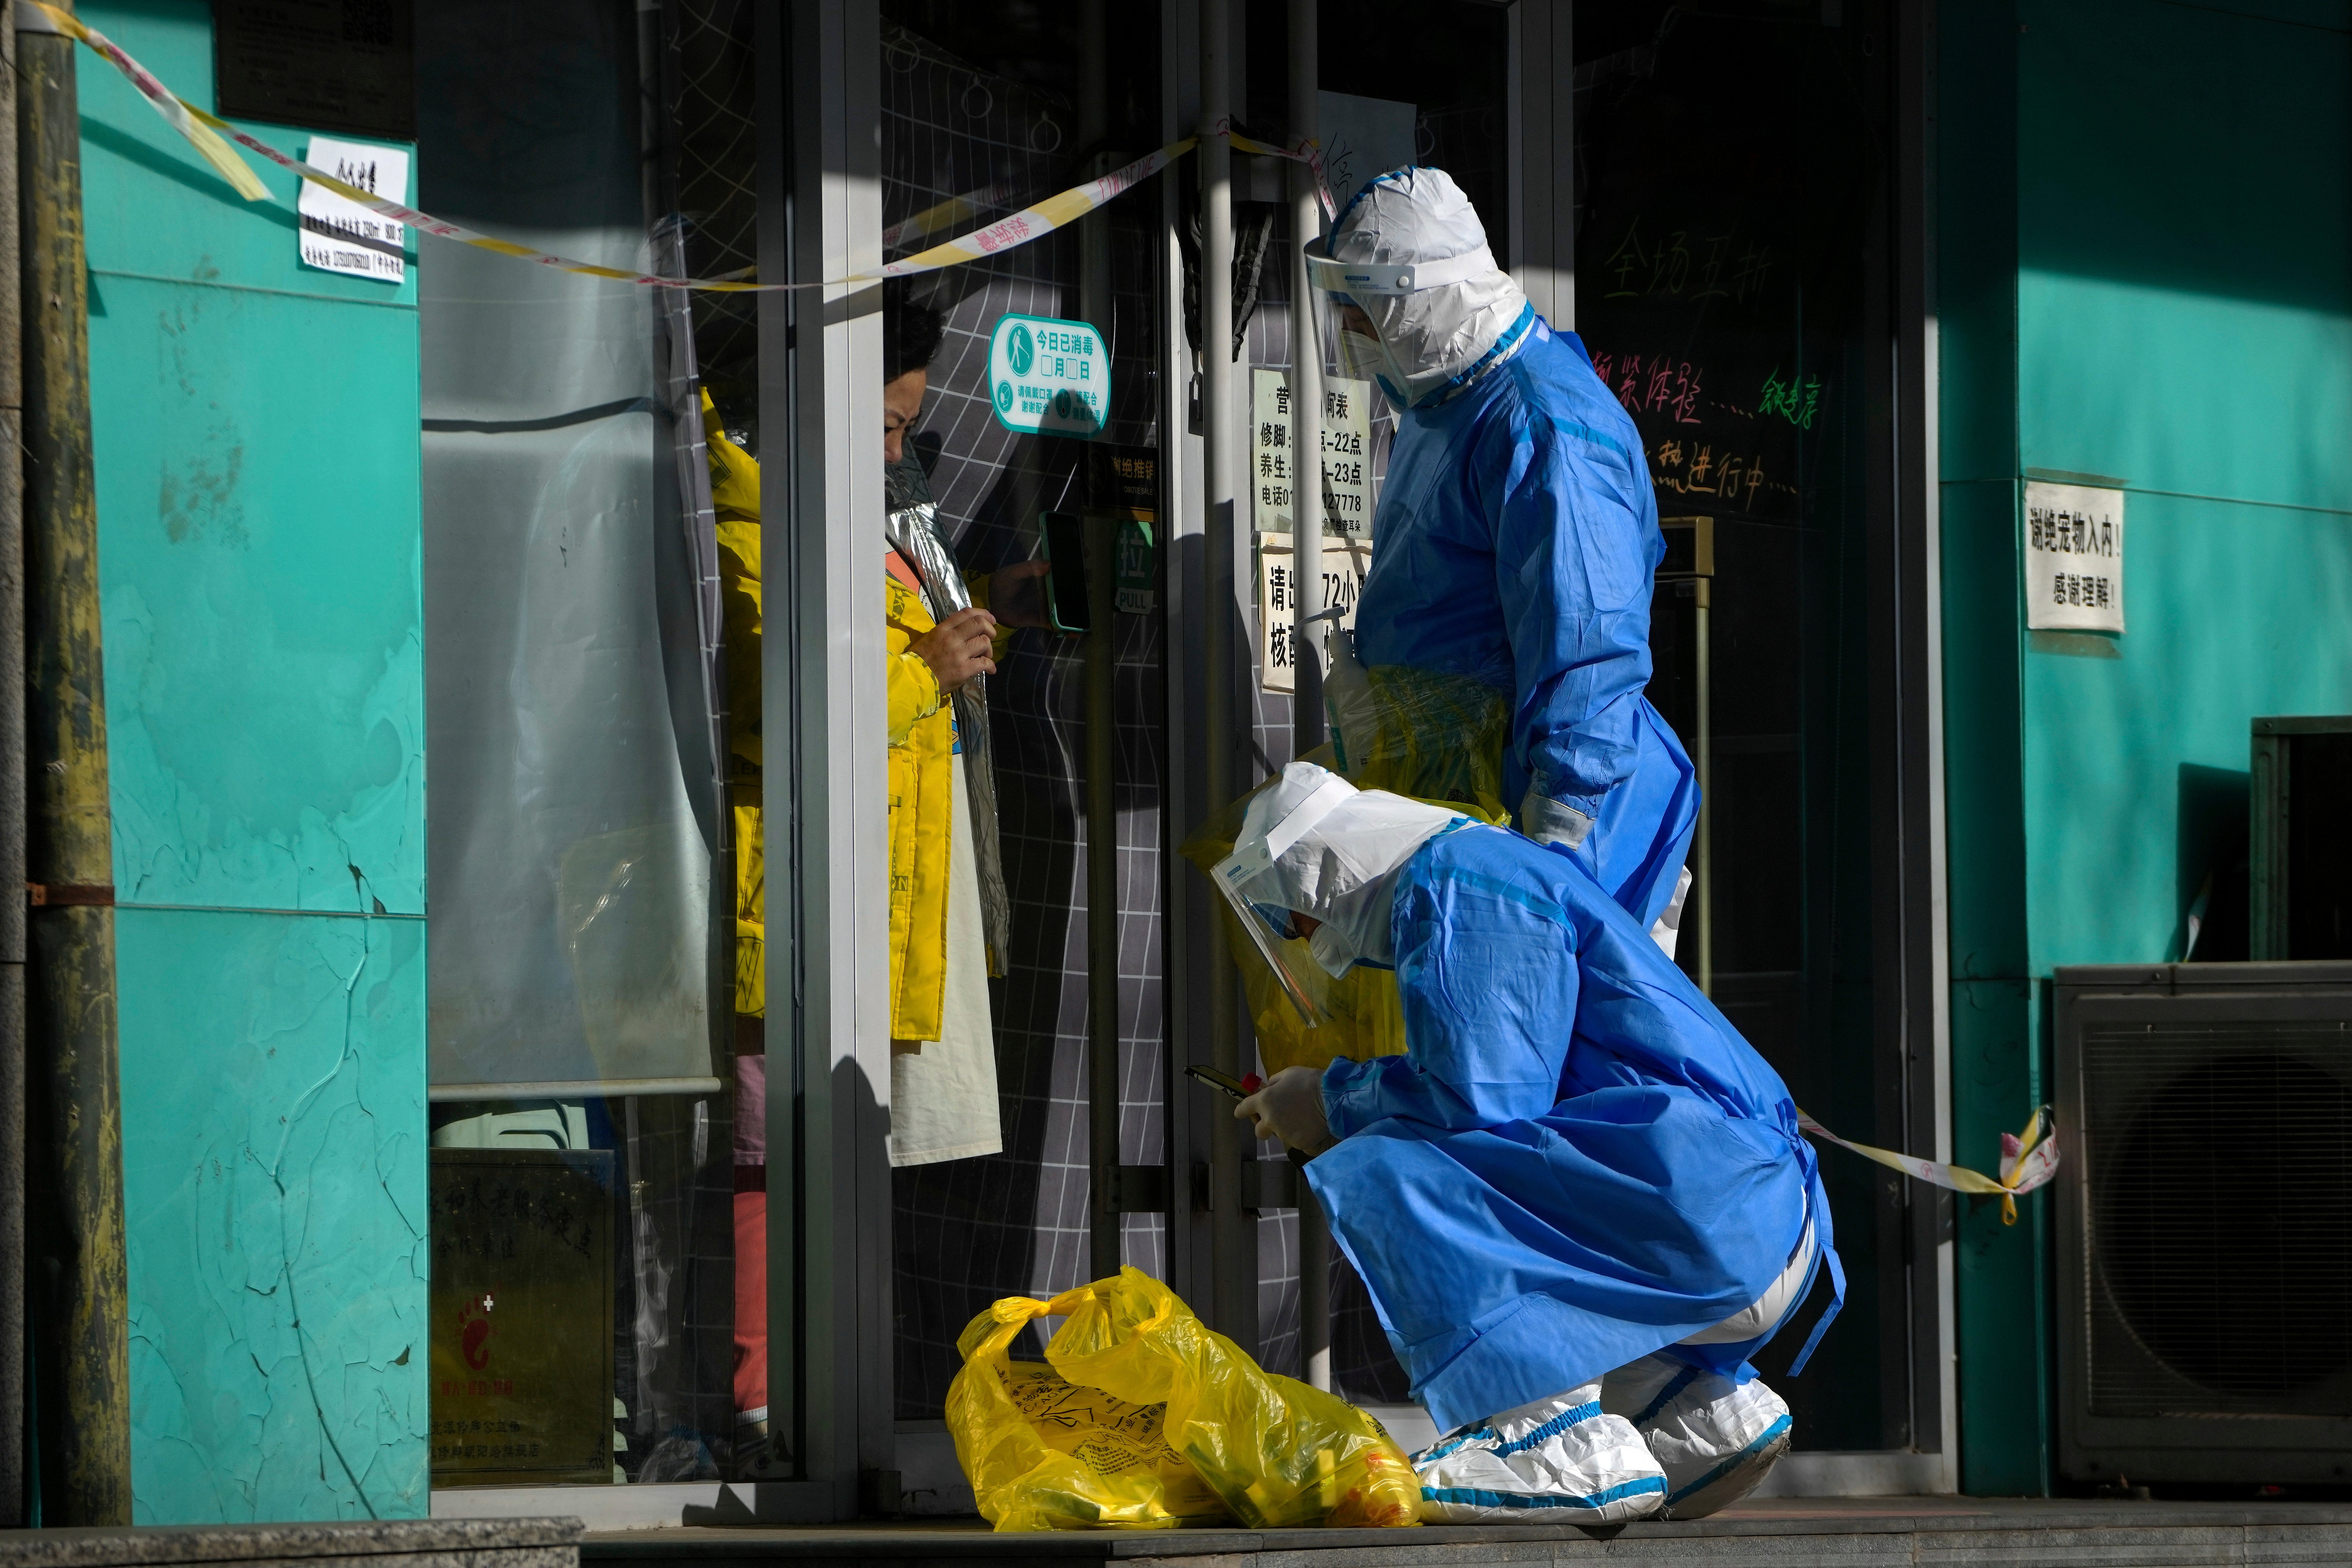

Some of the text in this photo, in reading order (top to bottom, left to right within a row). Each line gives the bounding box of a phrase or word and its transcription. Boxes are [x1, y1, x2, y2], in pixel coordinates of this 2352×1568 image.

[1037, 330, 1093, 356] 今日已消毒
[1018, 385, 1053, 401] 请佩戴口罩
[1076, 390, 1097, 406] 请配合
[1022, 400, 1049, 415] 谢谢配合
[1120, 529, 1146, 578] 拉
[1120, 592, 1146, 610] PULL
